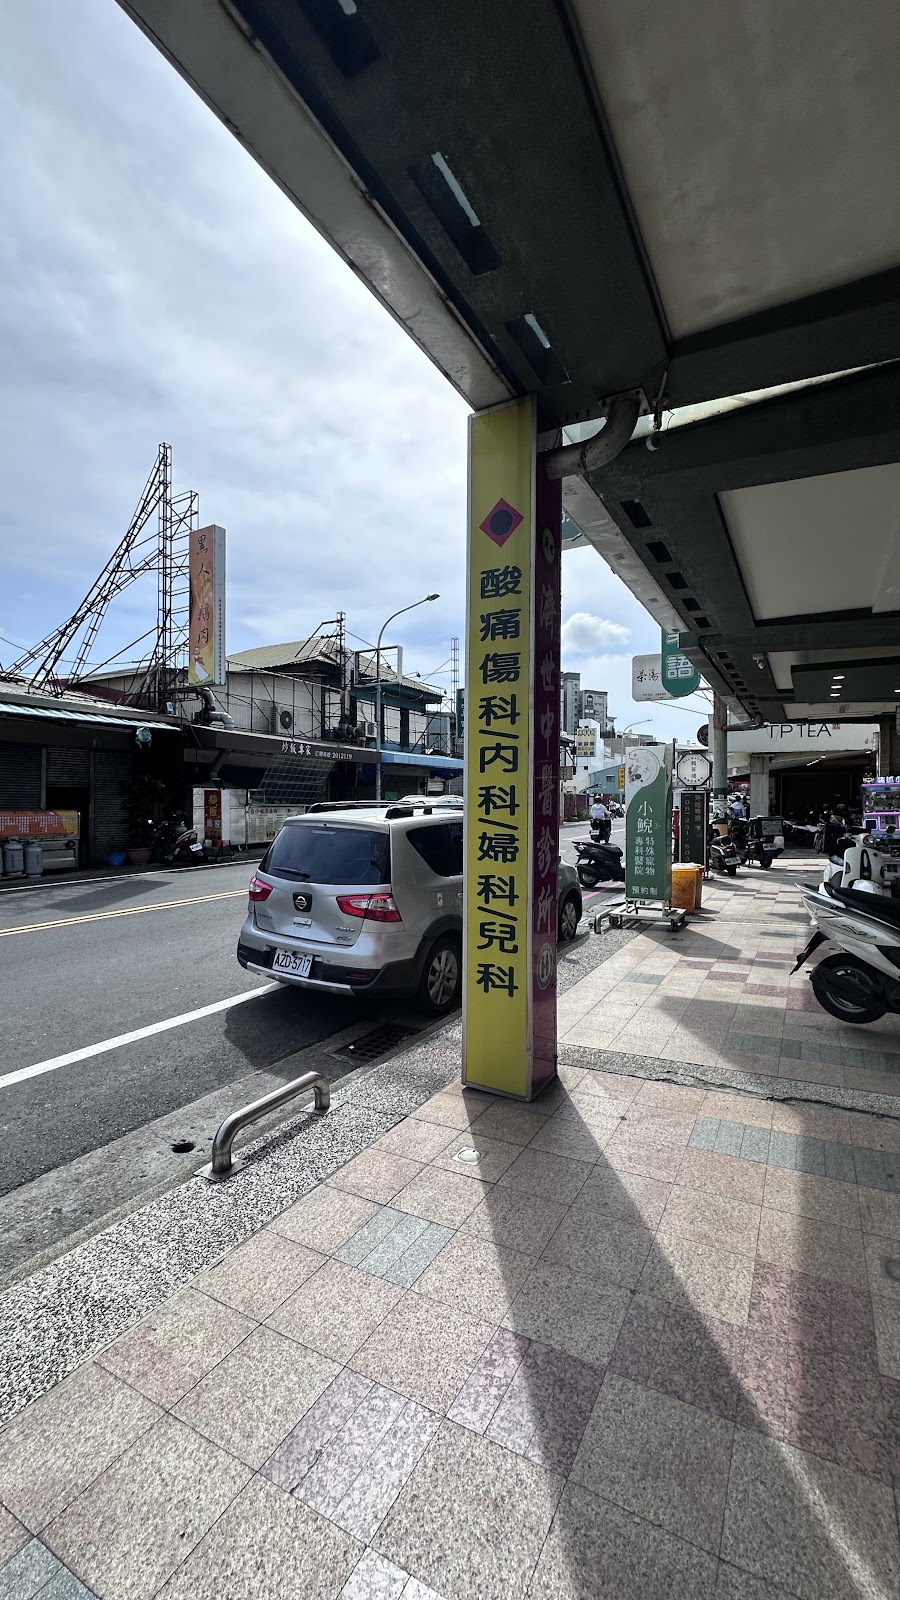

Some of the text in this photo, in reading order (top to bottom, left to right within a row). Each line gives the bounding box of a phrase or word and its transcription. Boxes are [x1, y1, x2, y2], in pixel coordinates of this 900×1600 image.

[797, 723, 832, 738] TEA
[634, 837, 644, 875] 專科醫院
[645, 837, 656, 875] 特殊寵物
[631, 886, 658, 895] 預約制
[274, 951, 312, 973] AZD-3717
